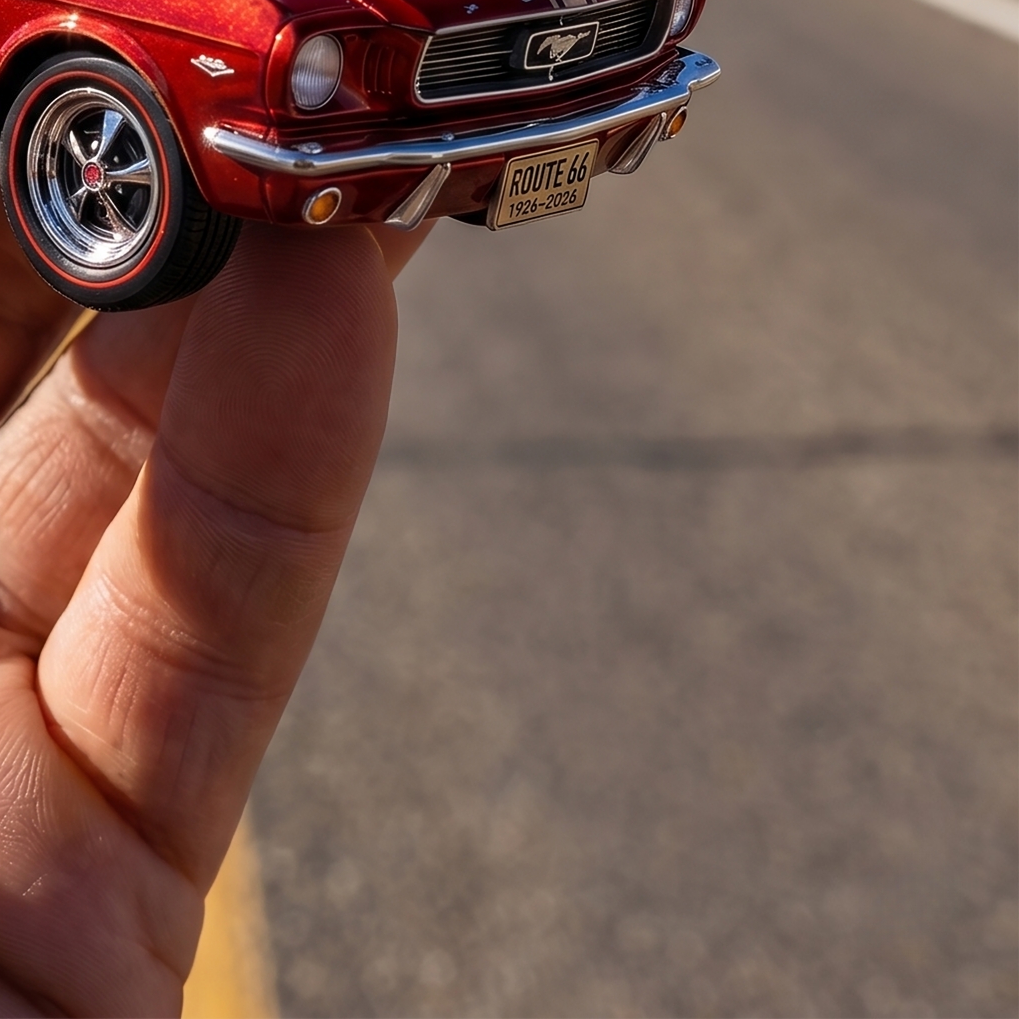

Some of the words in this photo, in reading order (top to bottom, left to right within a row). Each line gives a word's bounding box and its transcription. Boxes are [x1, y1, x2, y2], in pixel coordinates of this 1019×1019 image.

[509, 158, 567, 197] ROUTE
[567, 152, 590, 184] 66
[509, 189, 577, 218] 1926-2026
